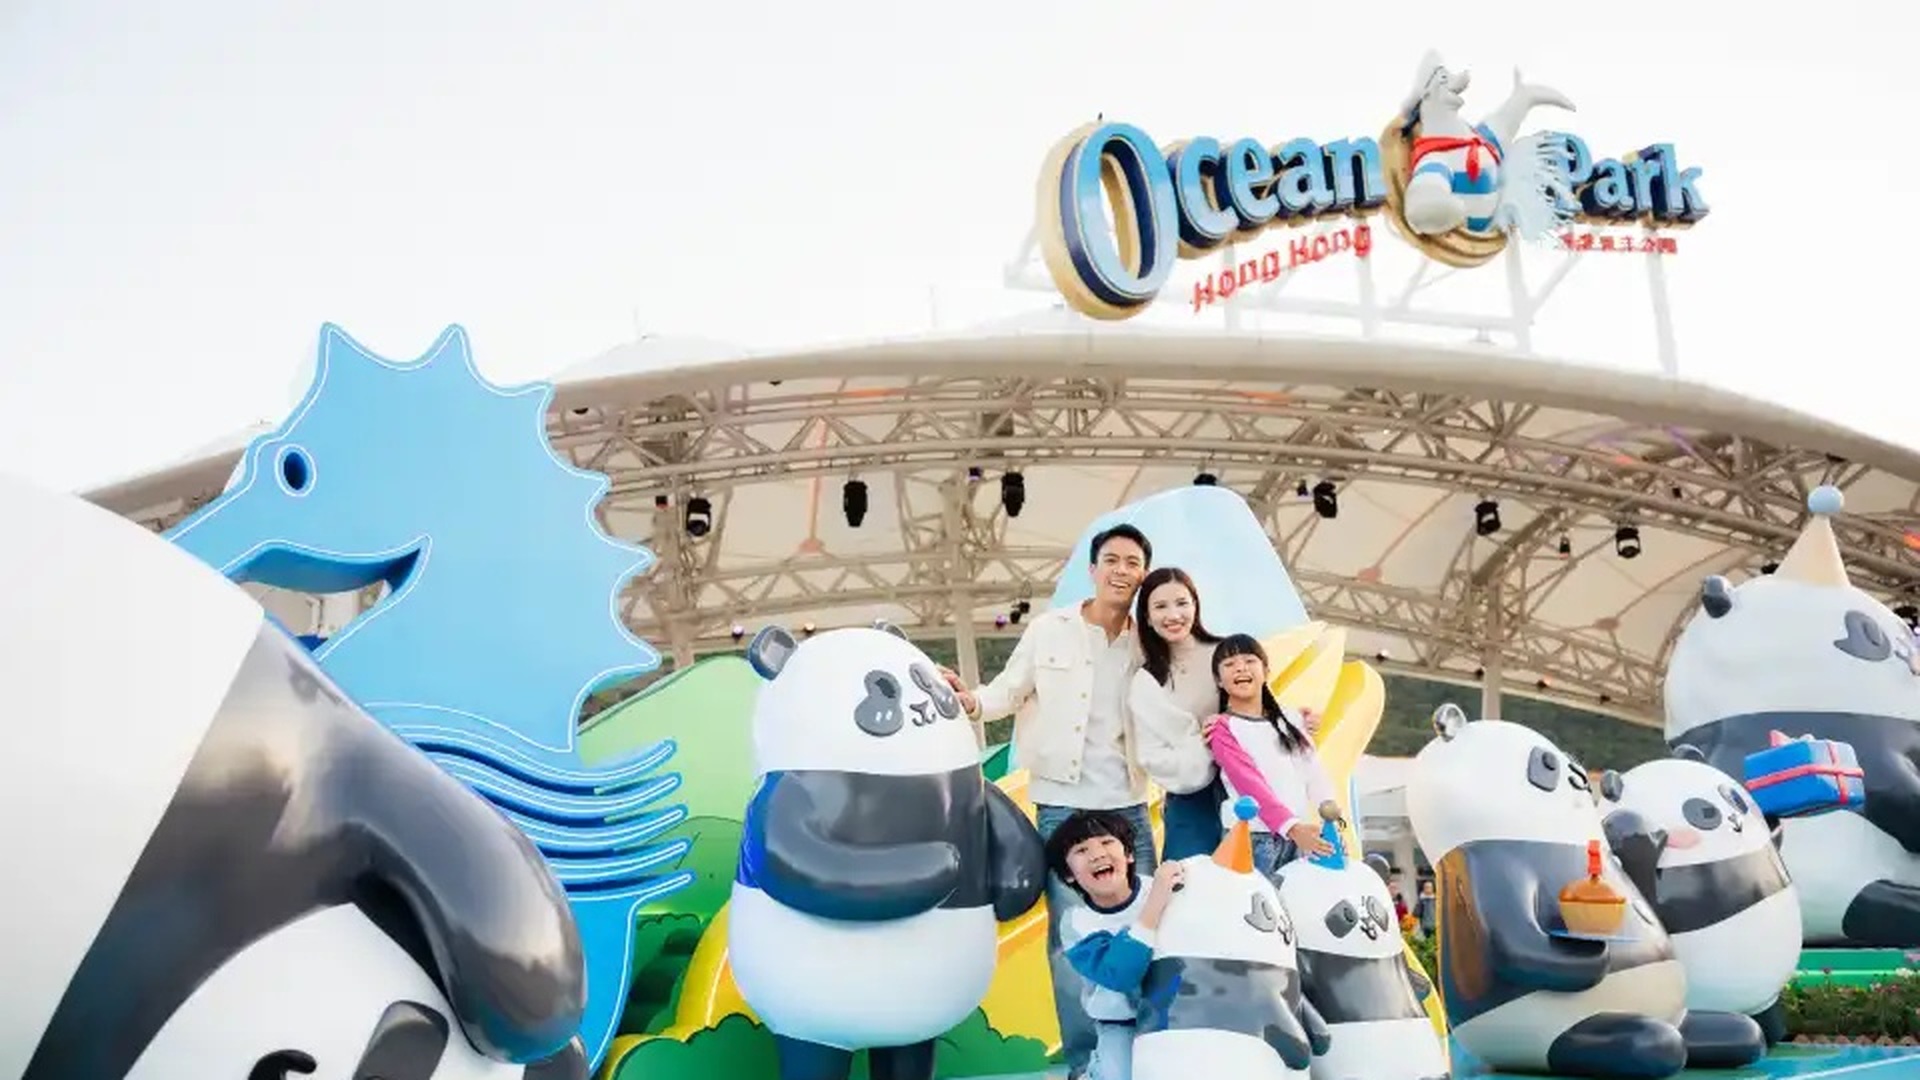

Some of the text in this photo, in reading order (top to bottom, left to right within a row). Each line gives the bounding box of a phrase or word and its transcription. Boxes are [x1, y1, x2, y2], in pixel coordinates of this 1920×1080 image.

[1060, 122, 1706, 306] Ocean Park
[1193, 224, 1371, 312] Hong Kong
